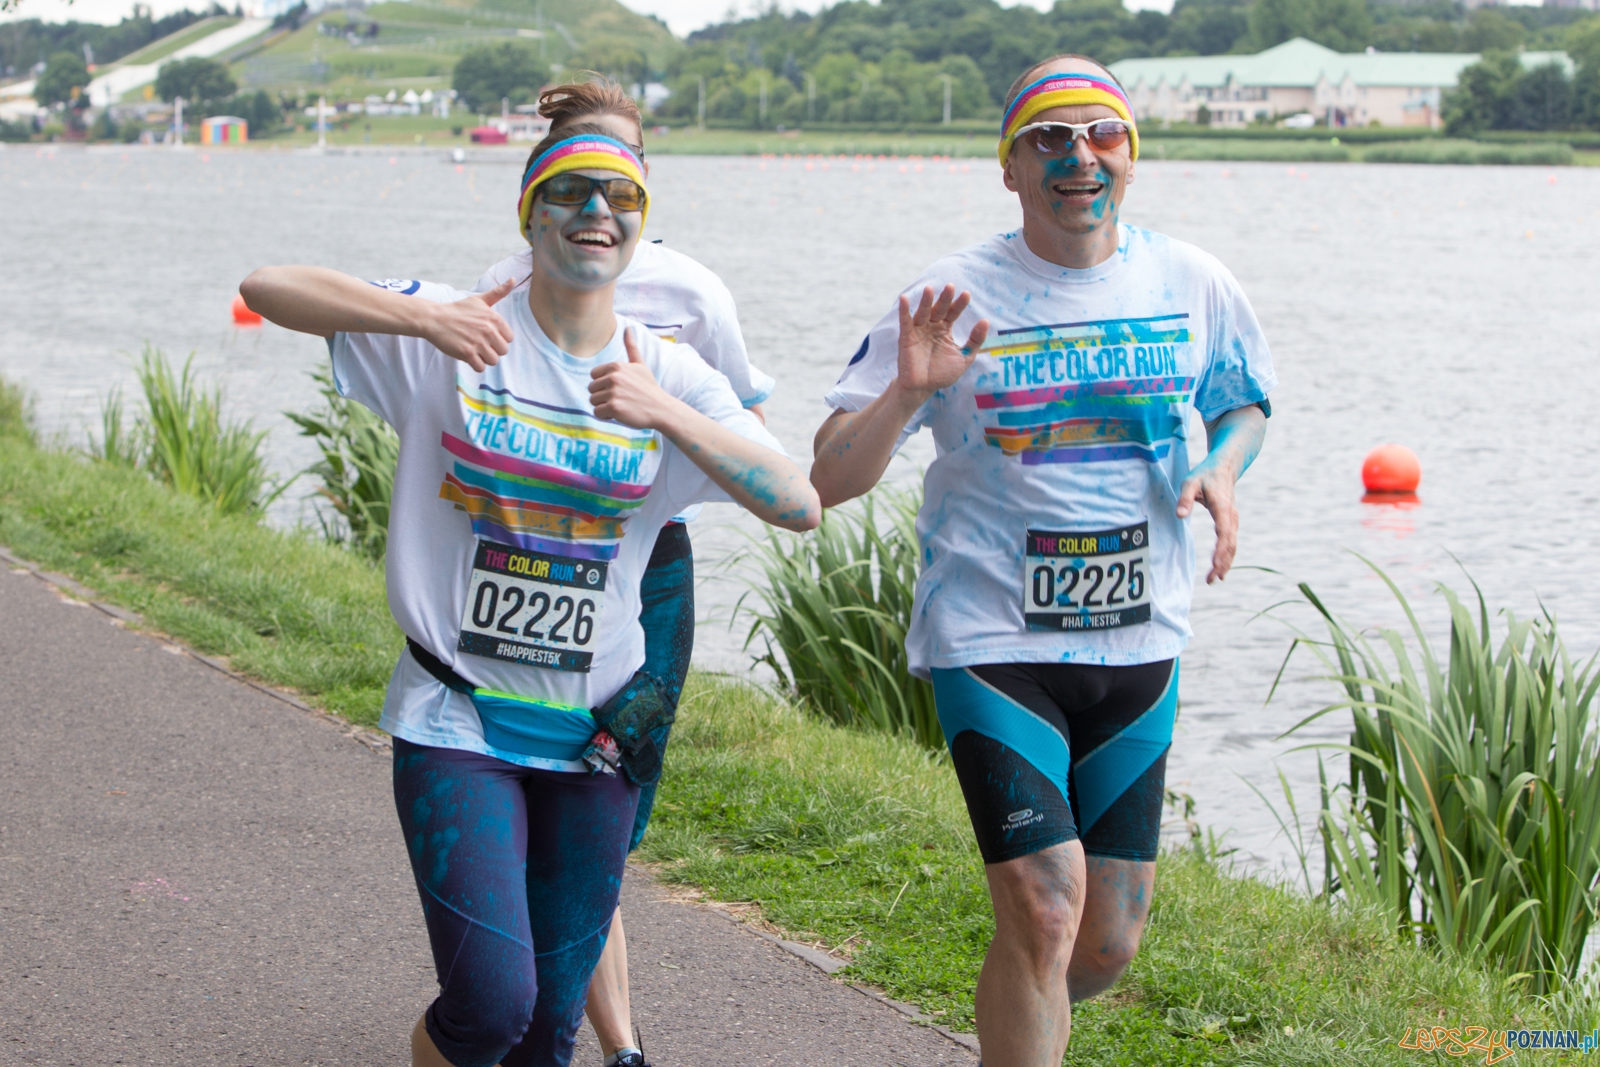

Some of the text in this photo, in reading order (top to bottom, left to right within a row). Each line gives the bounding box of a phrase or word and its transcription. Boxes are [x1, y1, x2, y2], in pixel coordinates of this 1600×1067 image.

[1000, 345, 1177, 386] THE COLOR RUN
[465, 408, 644, 484] THE COLOR RUN
[1035, 535, 1120, 554] THE COLOR RUN
[485, 550, 575, 582] THE COLOR RUN
[1033, 558, 1144, 607] 02225
[472, 580, 596, 646] 02226
[496, 643, 562, 665] #HAPPIEST5K
